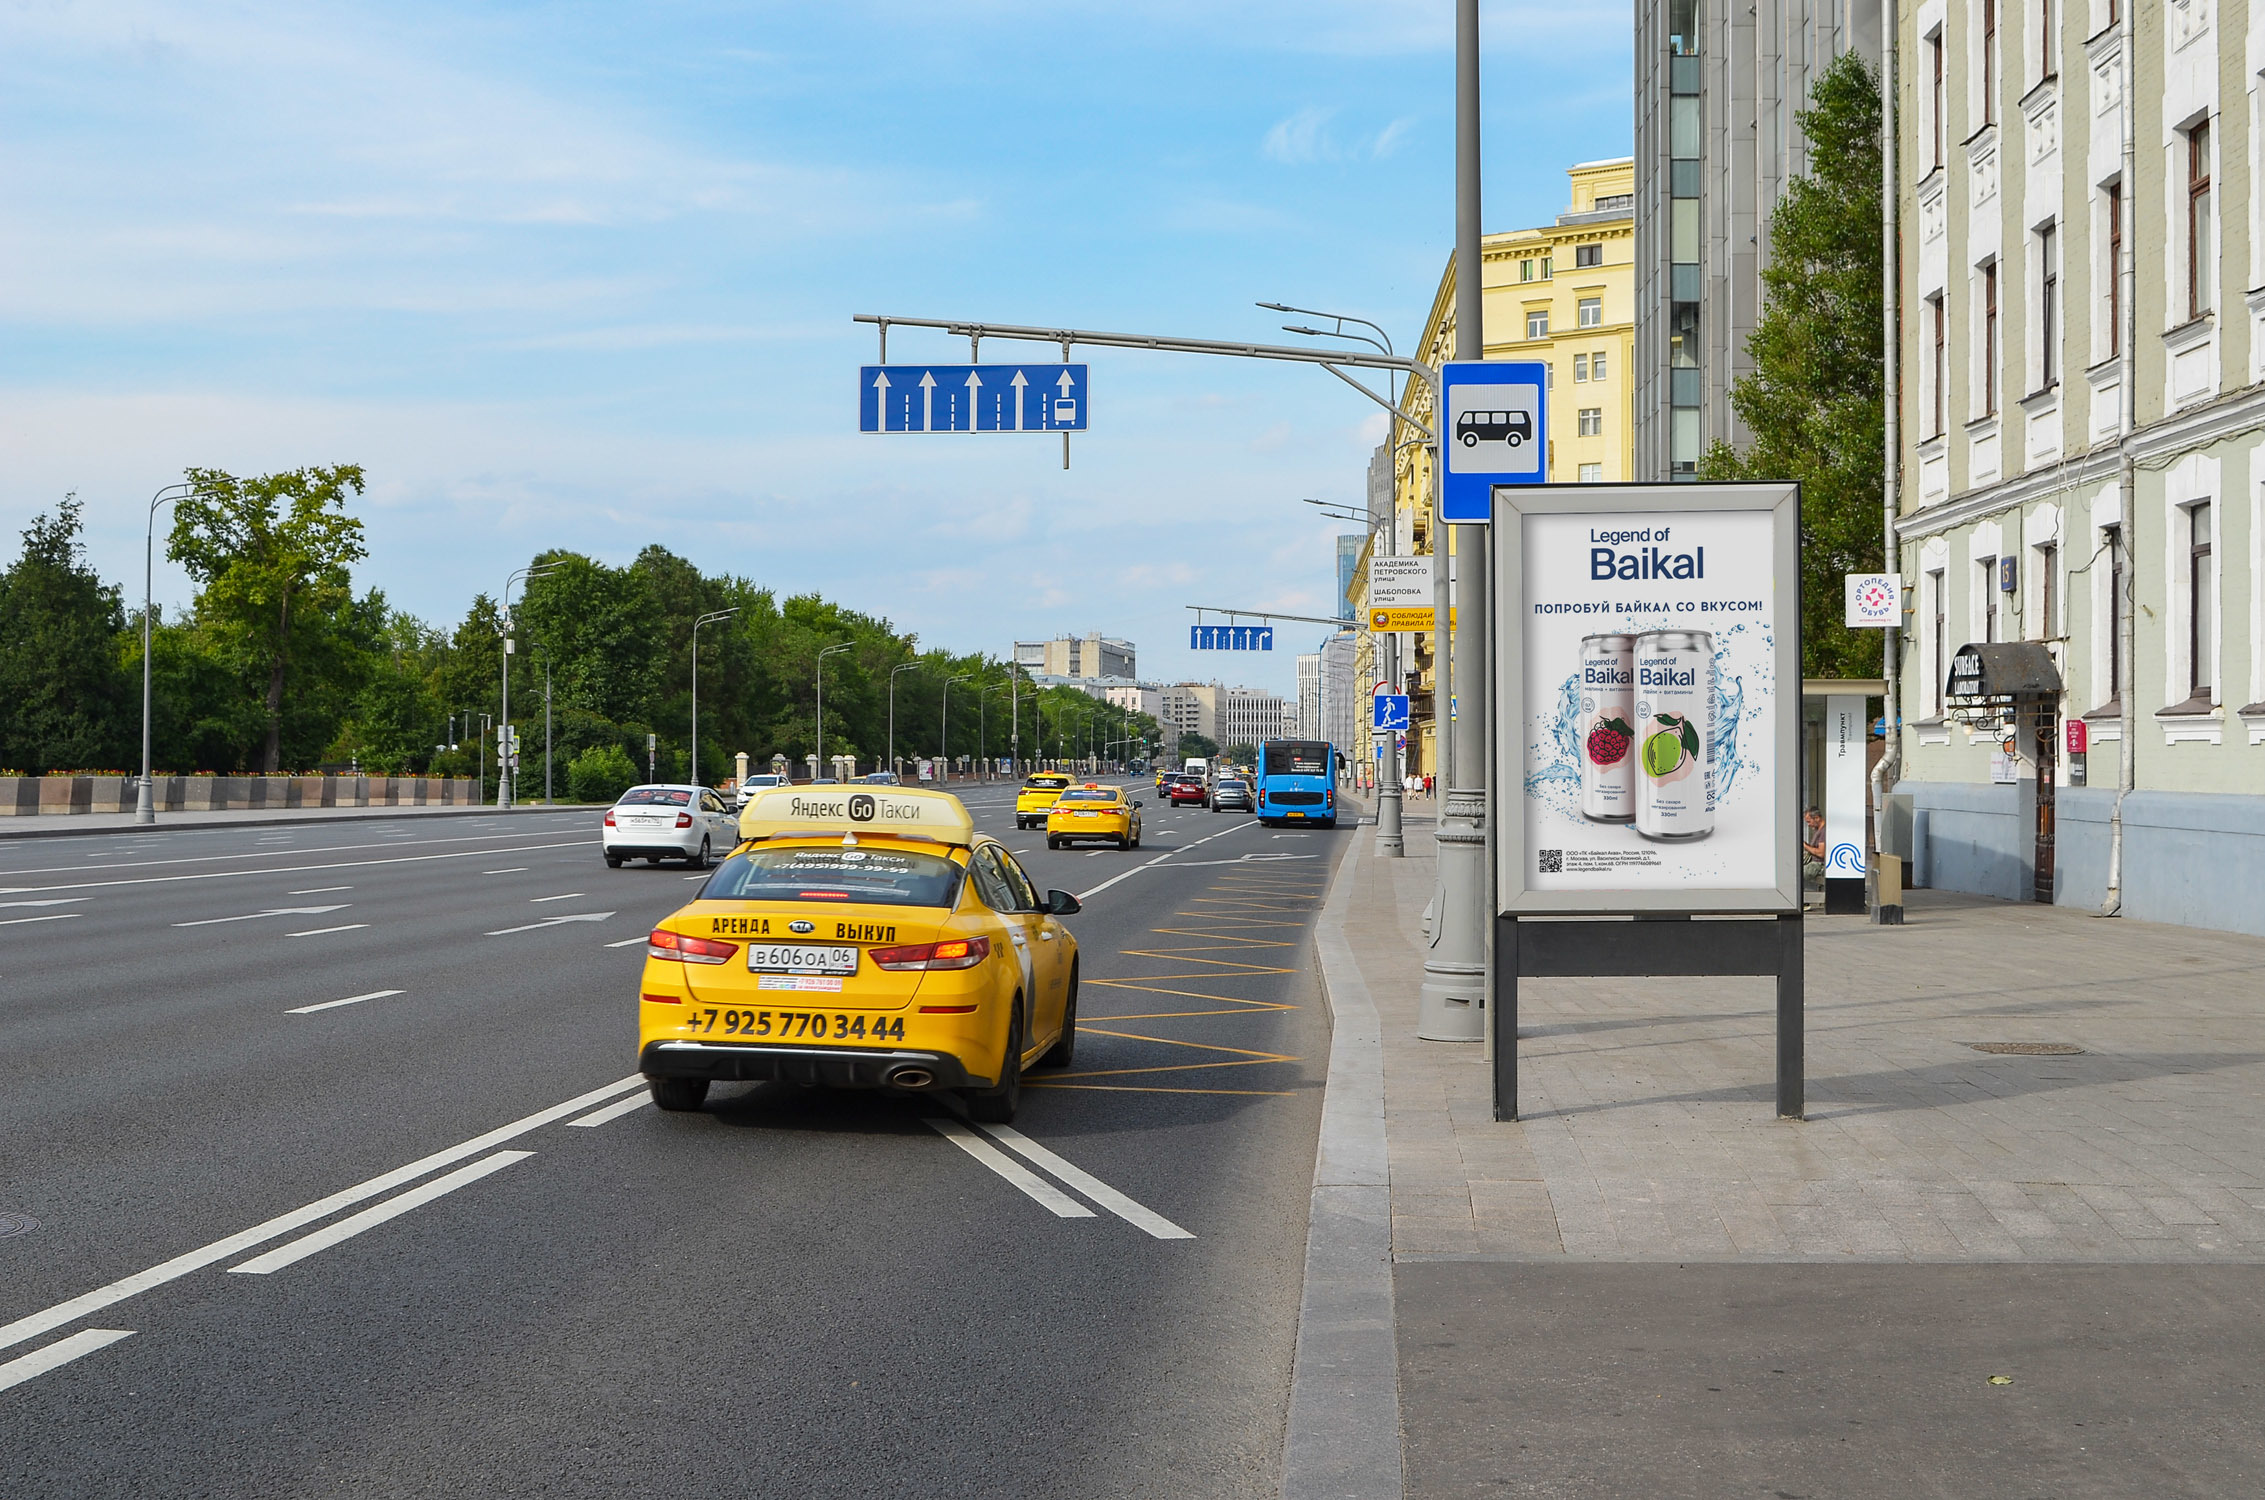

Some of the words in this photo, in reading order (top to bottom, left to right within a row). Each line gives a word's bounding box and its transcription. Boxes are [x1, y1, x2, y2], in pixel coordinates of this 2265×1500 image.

[1590, 527, 1650, 545] Legend
[1654, 527, 1670, 541] of
[1591, 546, 1704, 580] Baikal
[2002, 563, 2010, 583] 15
[1855, 578, 1894, 601] ОРТОПЕДИЯ
[1534, 601, 1610, 614] ПОПРОБУЙ
[1615, 600, 1671, 613] БАЙКАЛ
[1676, 602, 1695, 612] СО
[1701, 600, 1763, 612] ВКУСОМ!
[1861, 607, 1889, 616] ОБУВЬ
[1585, 659, 1610, 667] Legend
[1640, 657, 1668, 667] Legend
[1669, 657, 1677, 665] of
[1954, 654, 1979, 676] SURFACE
[1585, 667, 1634, 684] Baikal
[1640, 668, 1695, 686] Baikal
[1838, 712, 1847, 758] Травмпункт
[791, 797, 844, 818] Яндекс
[851, 798, 873, 819] Go
[879, 800, 920, 820] Такси
[793, 852, 841, 860] Яндекс
[870, 854, 905, 863] Такси
[712, 918, 770, 935] АРЕНДА
[836, 923, 896, 942] ВЫКУП
[790, 922, 811, 932] KIA
[756, 948, 827, 967] В606ОА
[833, 949, 850, 963] 06
[687, 1009, 718, 1033] +7
[724, 1010, 771, 1036] 925
[779, 1013, 827, 1038] 770
[833, 1014, 866, 1040] 34
[871, 1016, 905, 1041] 44
